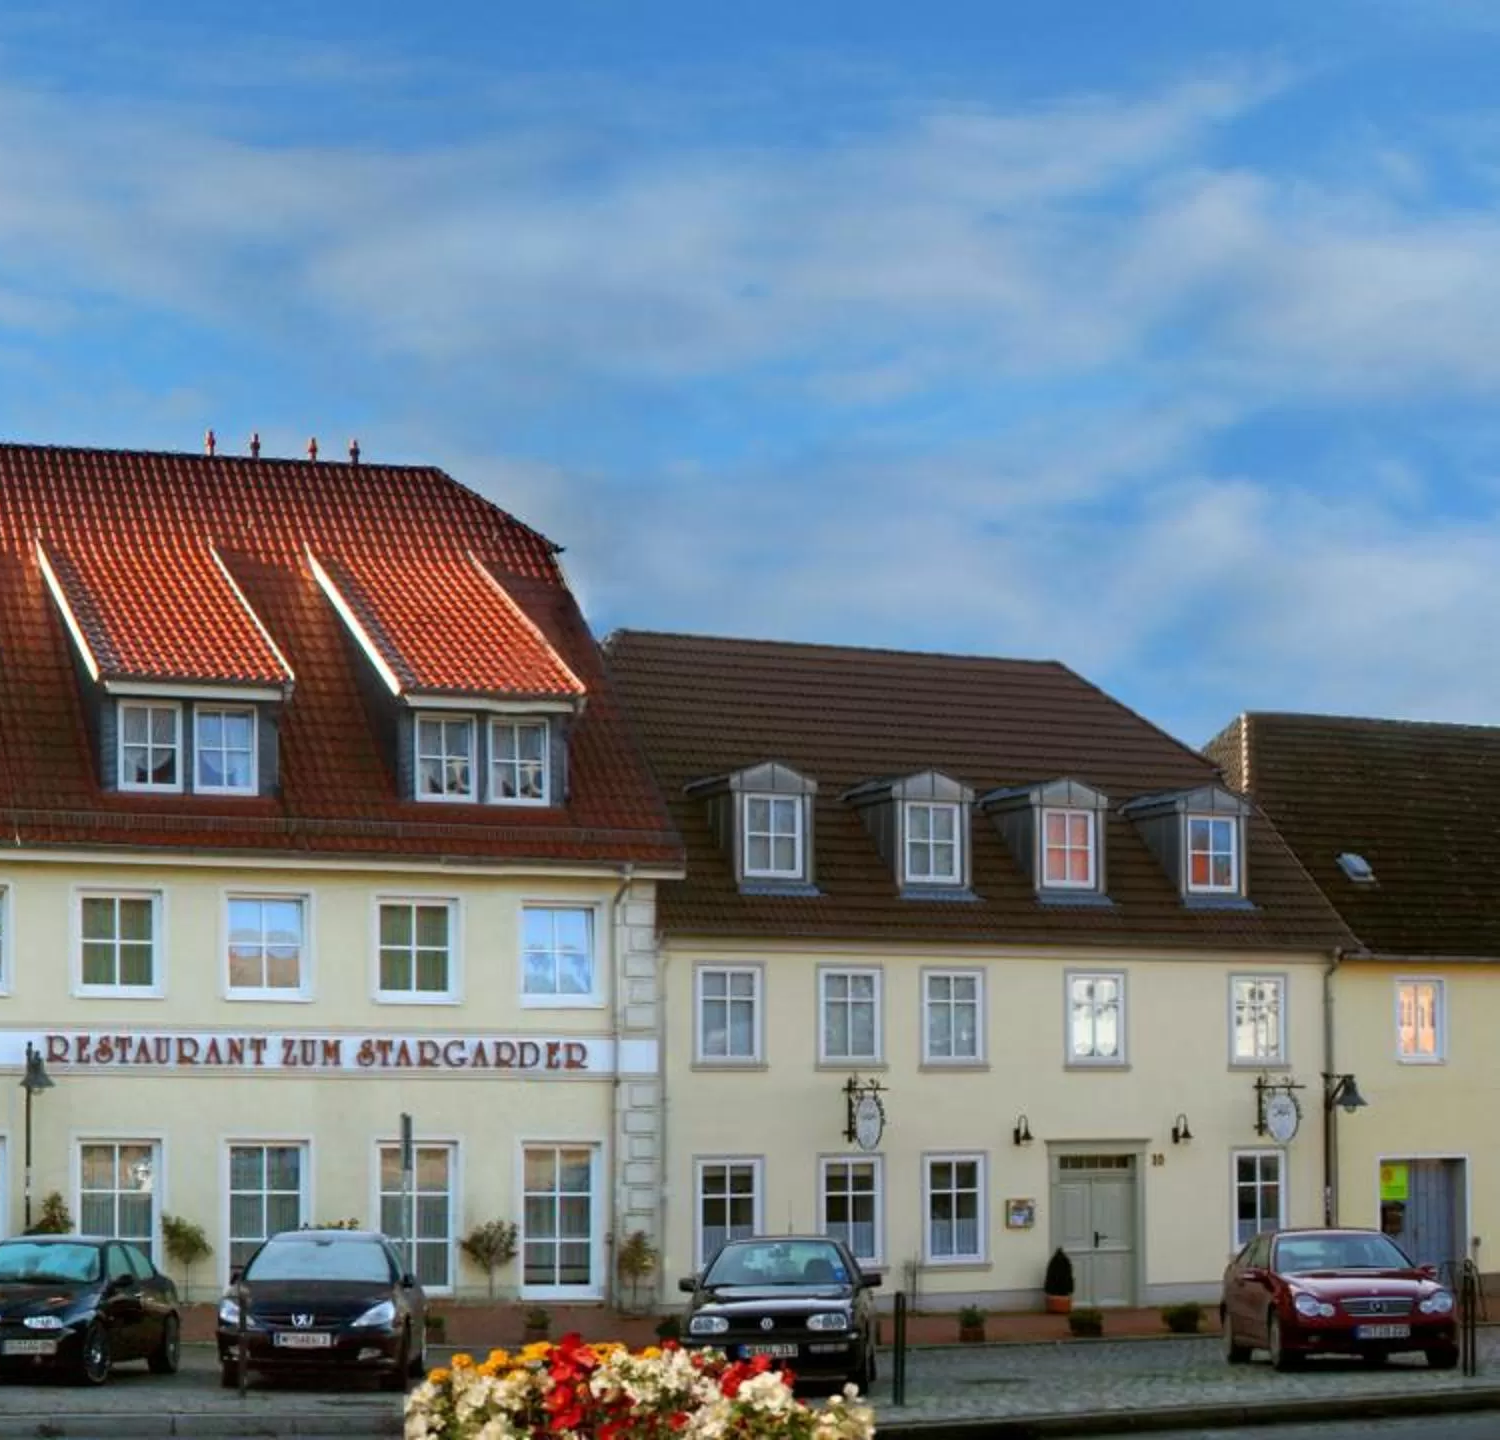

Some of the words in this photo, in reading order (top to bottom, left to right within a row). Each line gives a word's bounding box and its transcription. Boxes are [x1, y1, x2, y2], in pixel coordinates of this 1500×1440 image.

[45, 1034, 267, 1066] RESTAURANT
[281, 1038, 343, 1067] ZUM
[355, 1038, 589, 1070] STARGARDER
